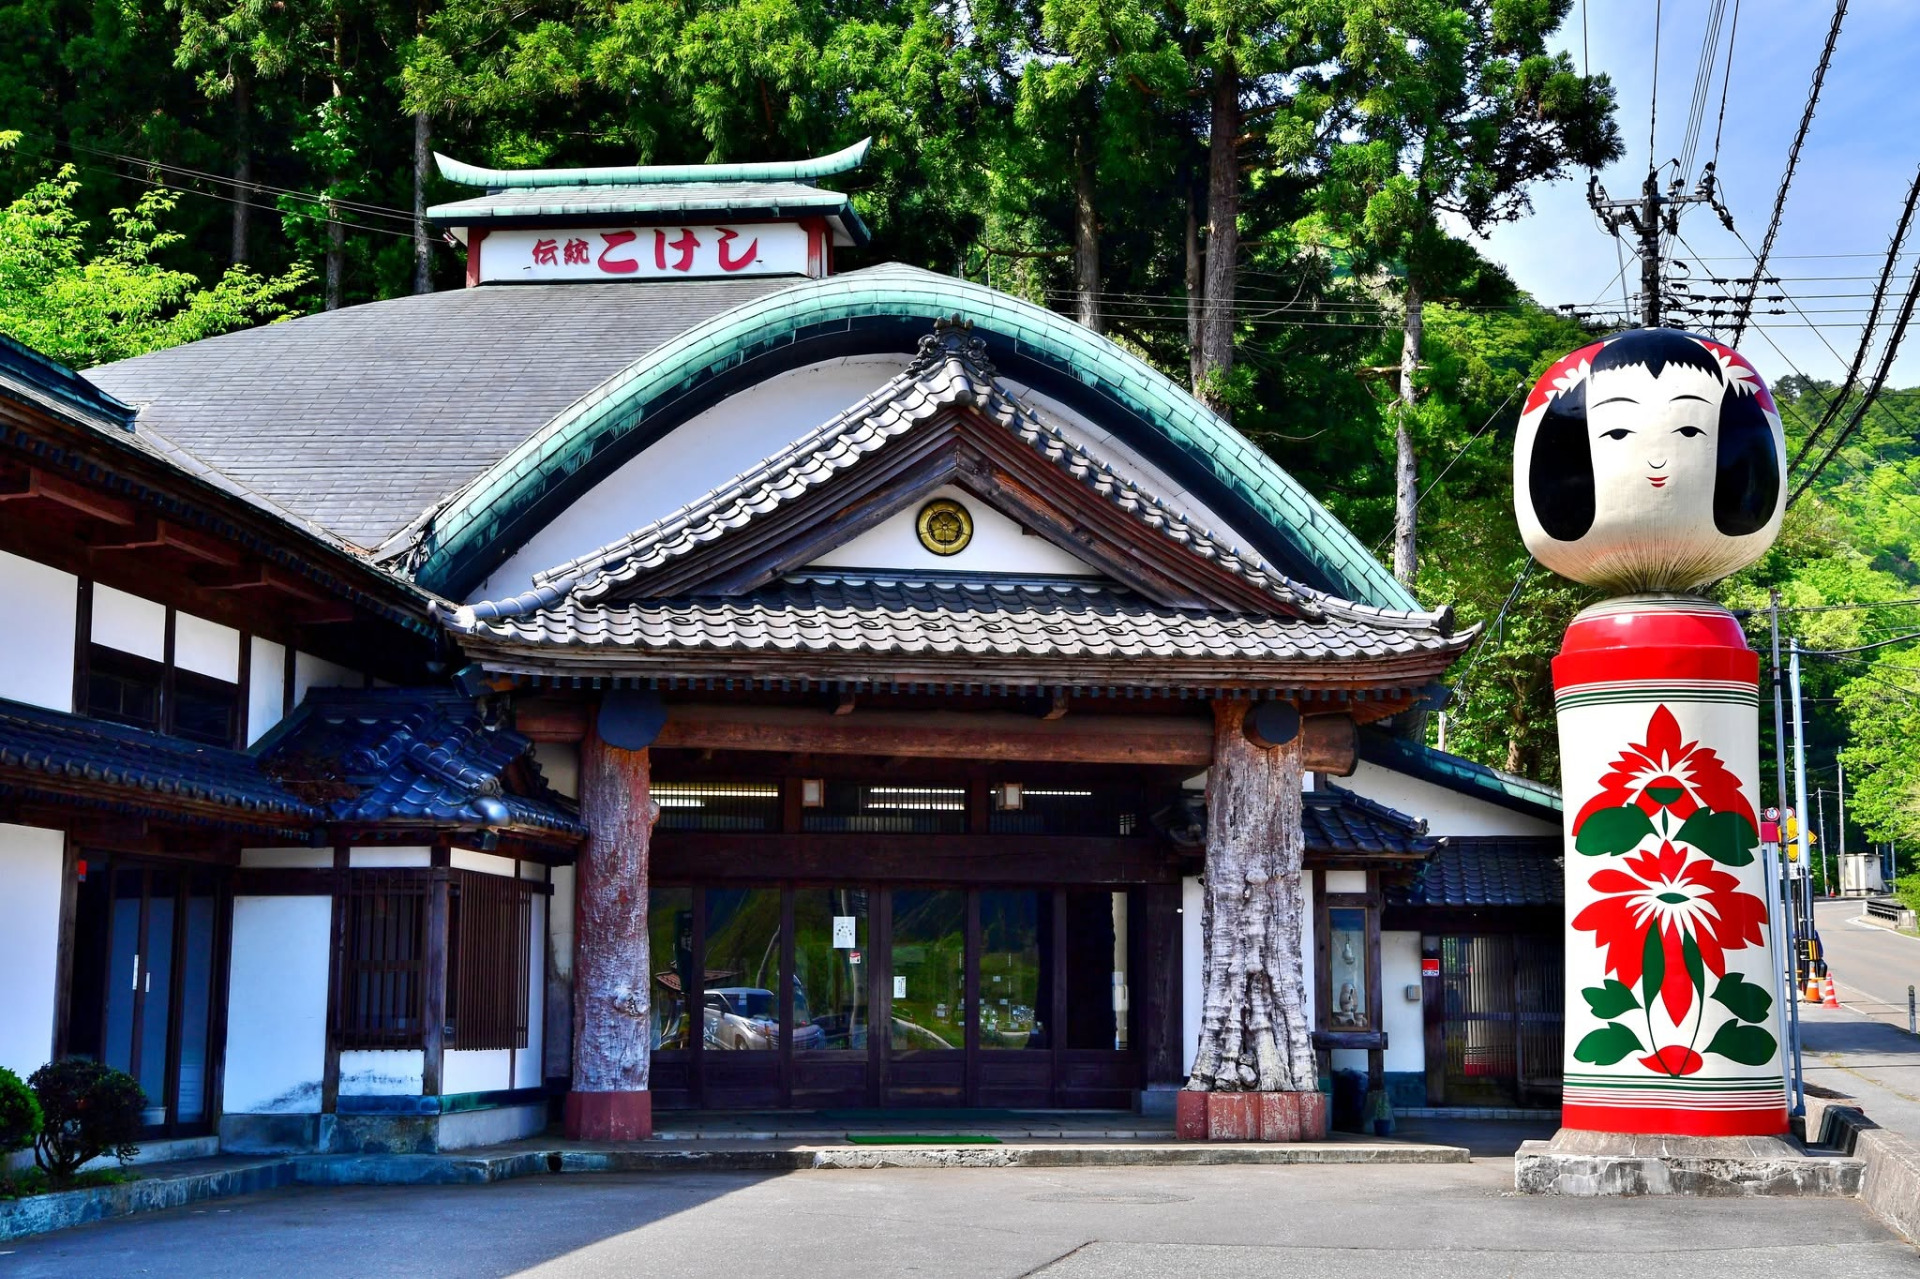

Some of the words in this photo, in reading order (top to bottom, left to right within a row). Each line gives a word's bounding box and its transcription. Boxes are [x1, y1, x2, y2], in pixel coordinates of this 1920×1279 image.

[532, 227, 758, 273] 伝統こけし
